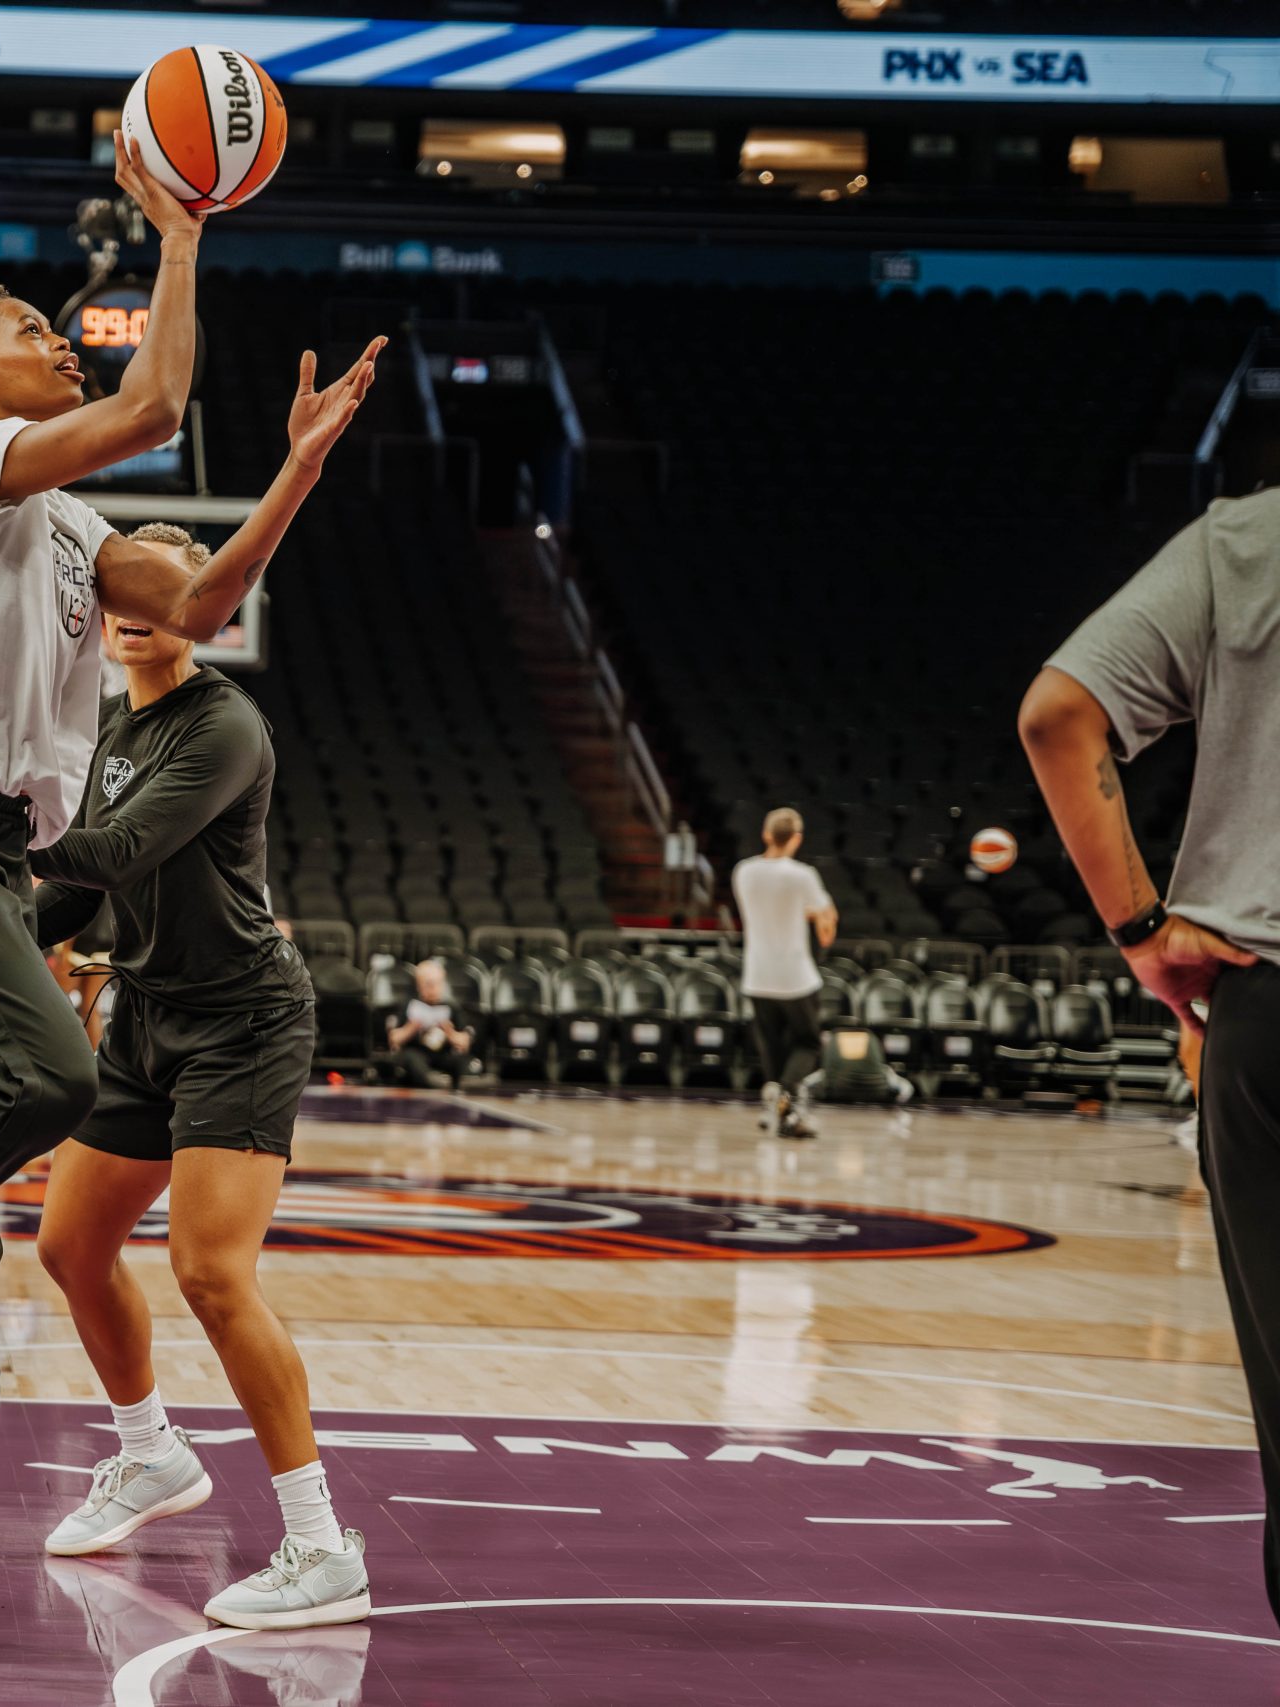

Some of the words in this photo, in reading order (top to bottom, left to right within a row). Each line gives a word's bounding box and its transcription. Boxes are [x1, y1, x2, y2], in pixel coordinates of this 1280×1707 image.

[882, 48, 963, 83] PHX
[1012, 50, 1090, 84] SEA
[218, 50, 254, 147] Wilson
[103, 766, 136, 778] FINALS
